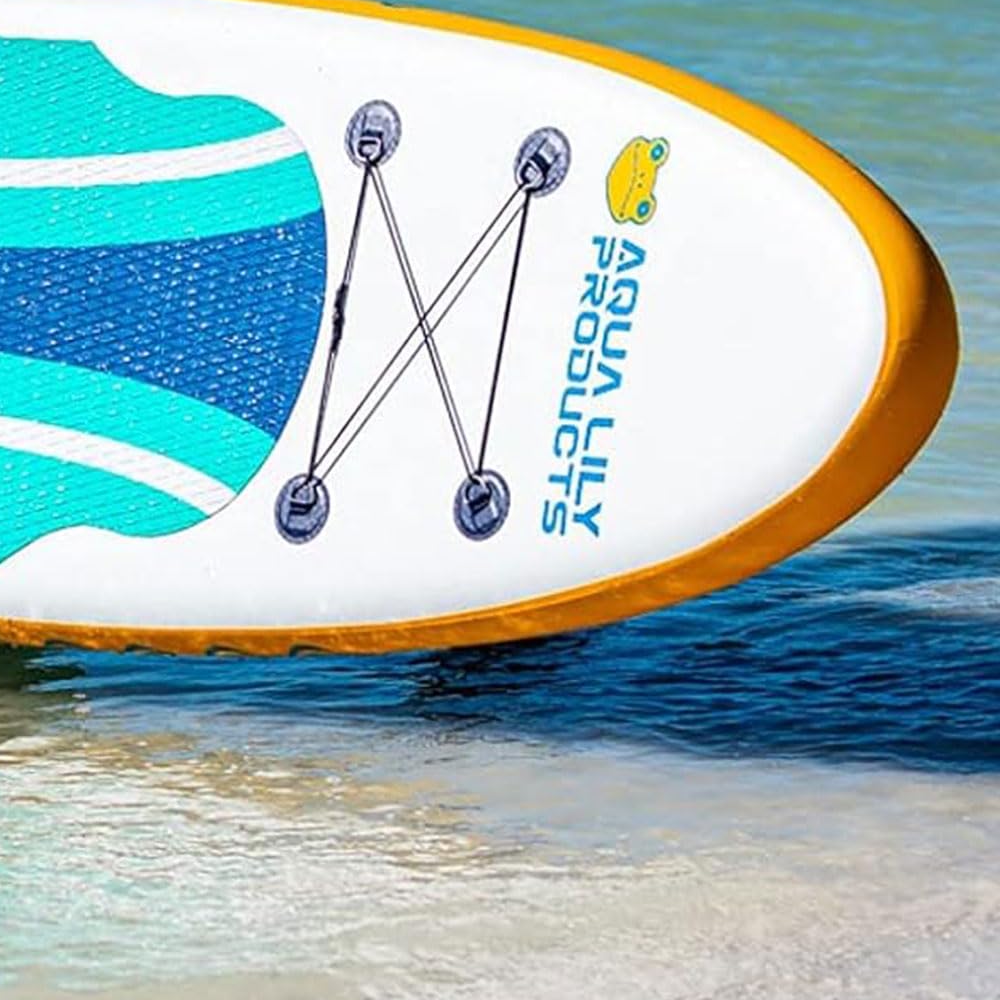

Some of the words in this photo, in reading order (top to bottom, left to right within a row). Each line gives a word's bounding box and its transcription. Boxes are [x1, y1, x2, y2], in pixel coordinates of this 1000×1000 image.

[542, 236, 616, 536] PRODUCTS
[592, 238, 647, 397] AQUA
[573, 417, 615, 537] LILY
